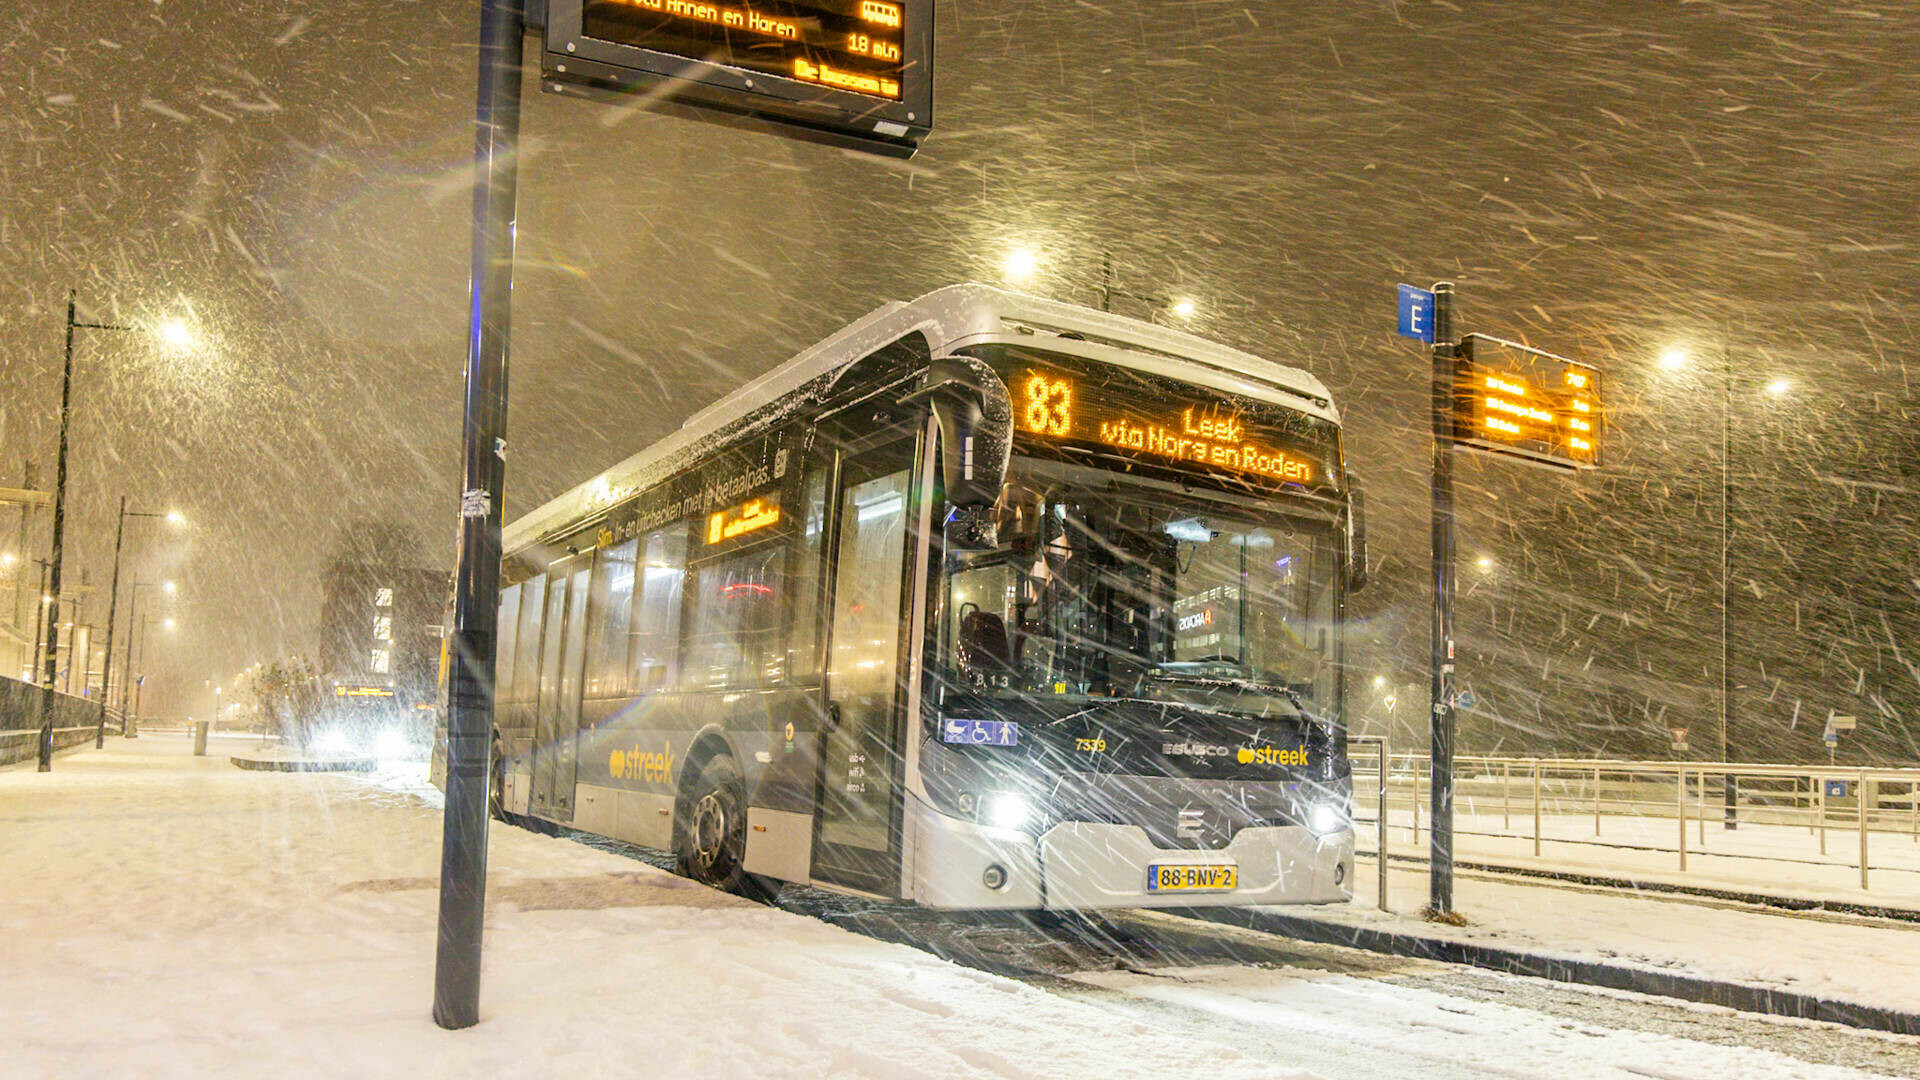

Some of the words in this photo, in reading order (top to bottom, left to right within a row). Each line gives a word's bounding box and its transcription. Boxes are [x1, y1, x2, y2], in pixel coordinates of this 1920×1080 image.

[723, 10, 743, 26] en
[749, 11, 796, 38] Haren
[848, 33, 868, 52] 18
[873, 42, 898, 59] min
[1411, 305, 1422, 333] E
[1025, 376, 1070, 436] 83
[1183, 407, 1240, 443] Leek
[1101, 419, 1144, 447] via
[1211, 446, 1239, 467] en
[1243, 445, 1310, 481] Roden
[682, 488, 702, 515] met
[702, 483, 714, 514] je
[715, 465, 771, 500] betaalpas.
[1075, 738, 1106, 752] 7339
[1255, 744, 1309, 766] streek
[624, 740, 673, 784] streek
[1161, 869, 1231, 886] 88-BNV-2
